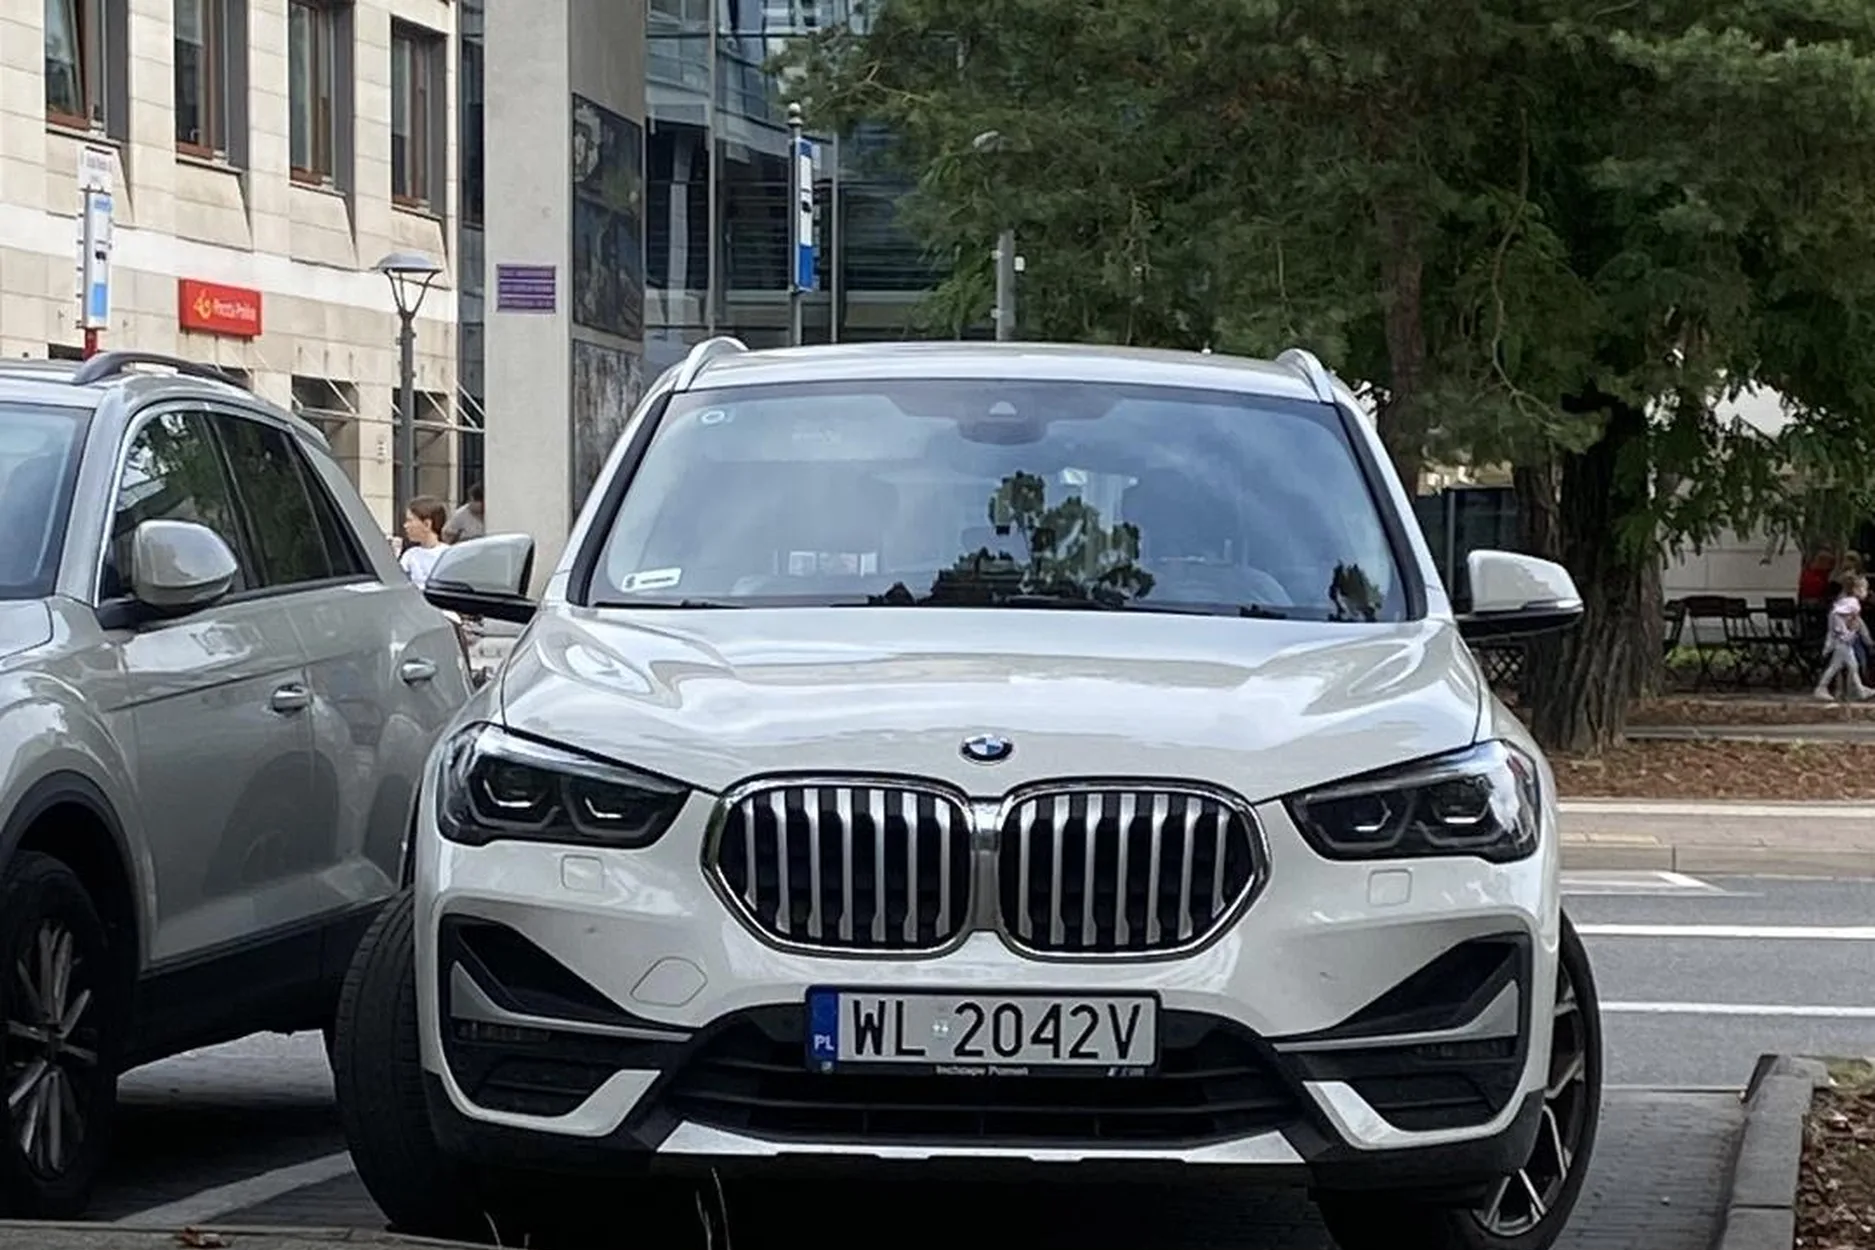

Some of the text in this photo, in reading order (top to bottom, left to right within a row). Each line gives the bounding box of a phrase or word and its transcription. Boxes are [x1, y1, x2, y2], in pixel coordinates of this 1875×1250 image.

[813, 1035, 835, 1050] PL
[852, 999, 1141, 1060] WL 2042V
